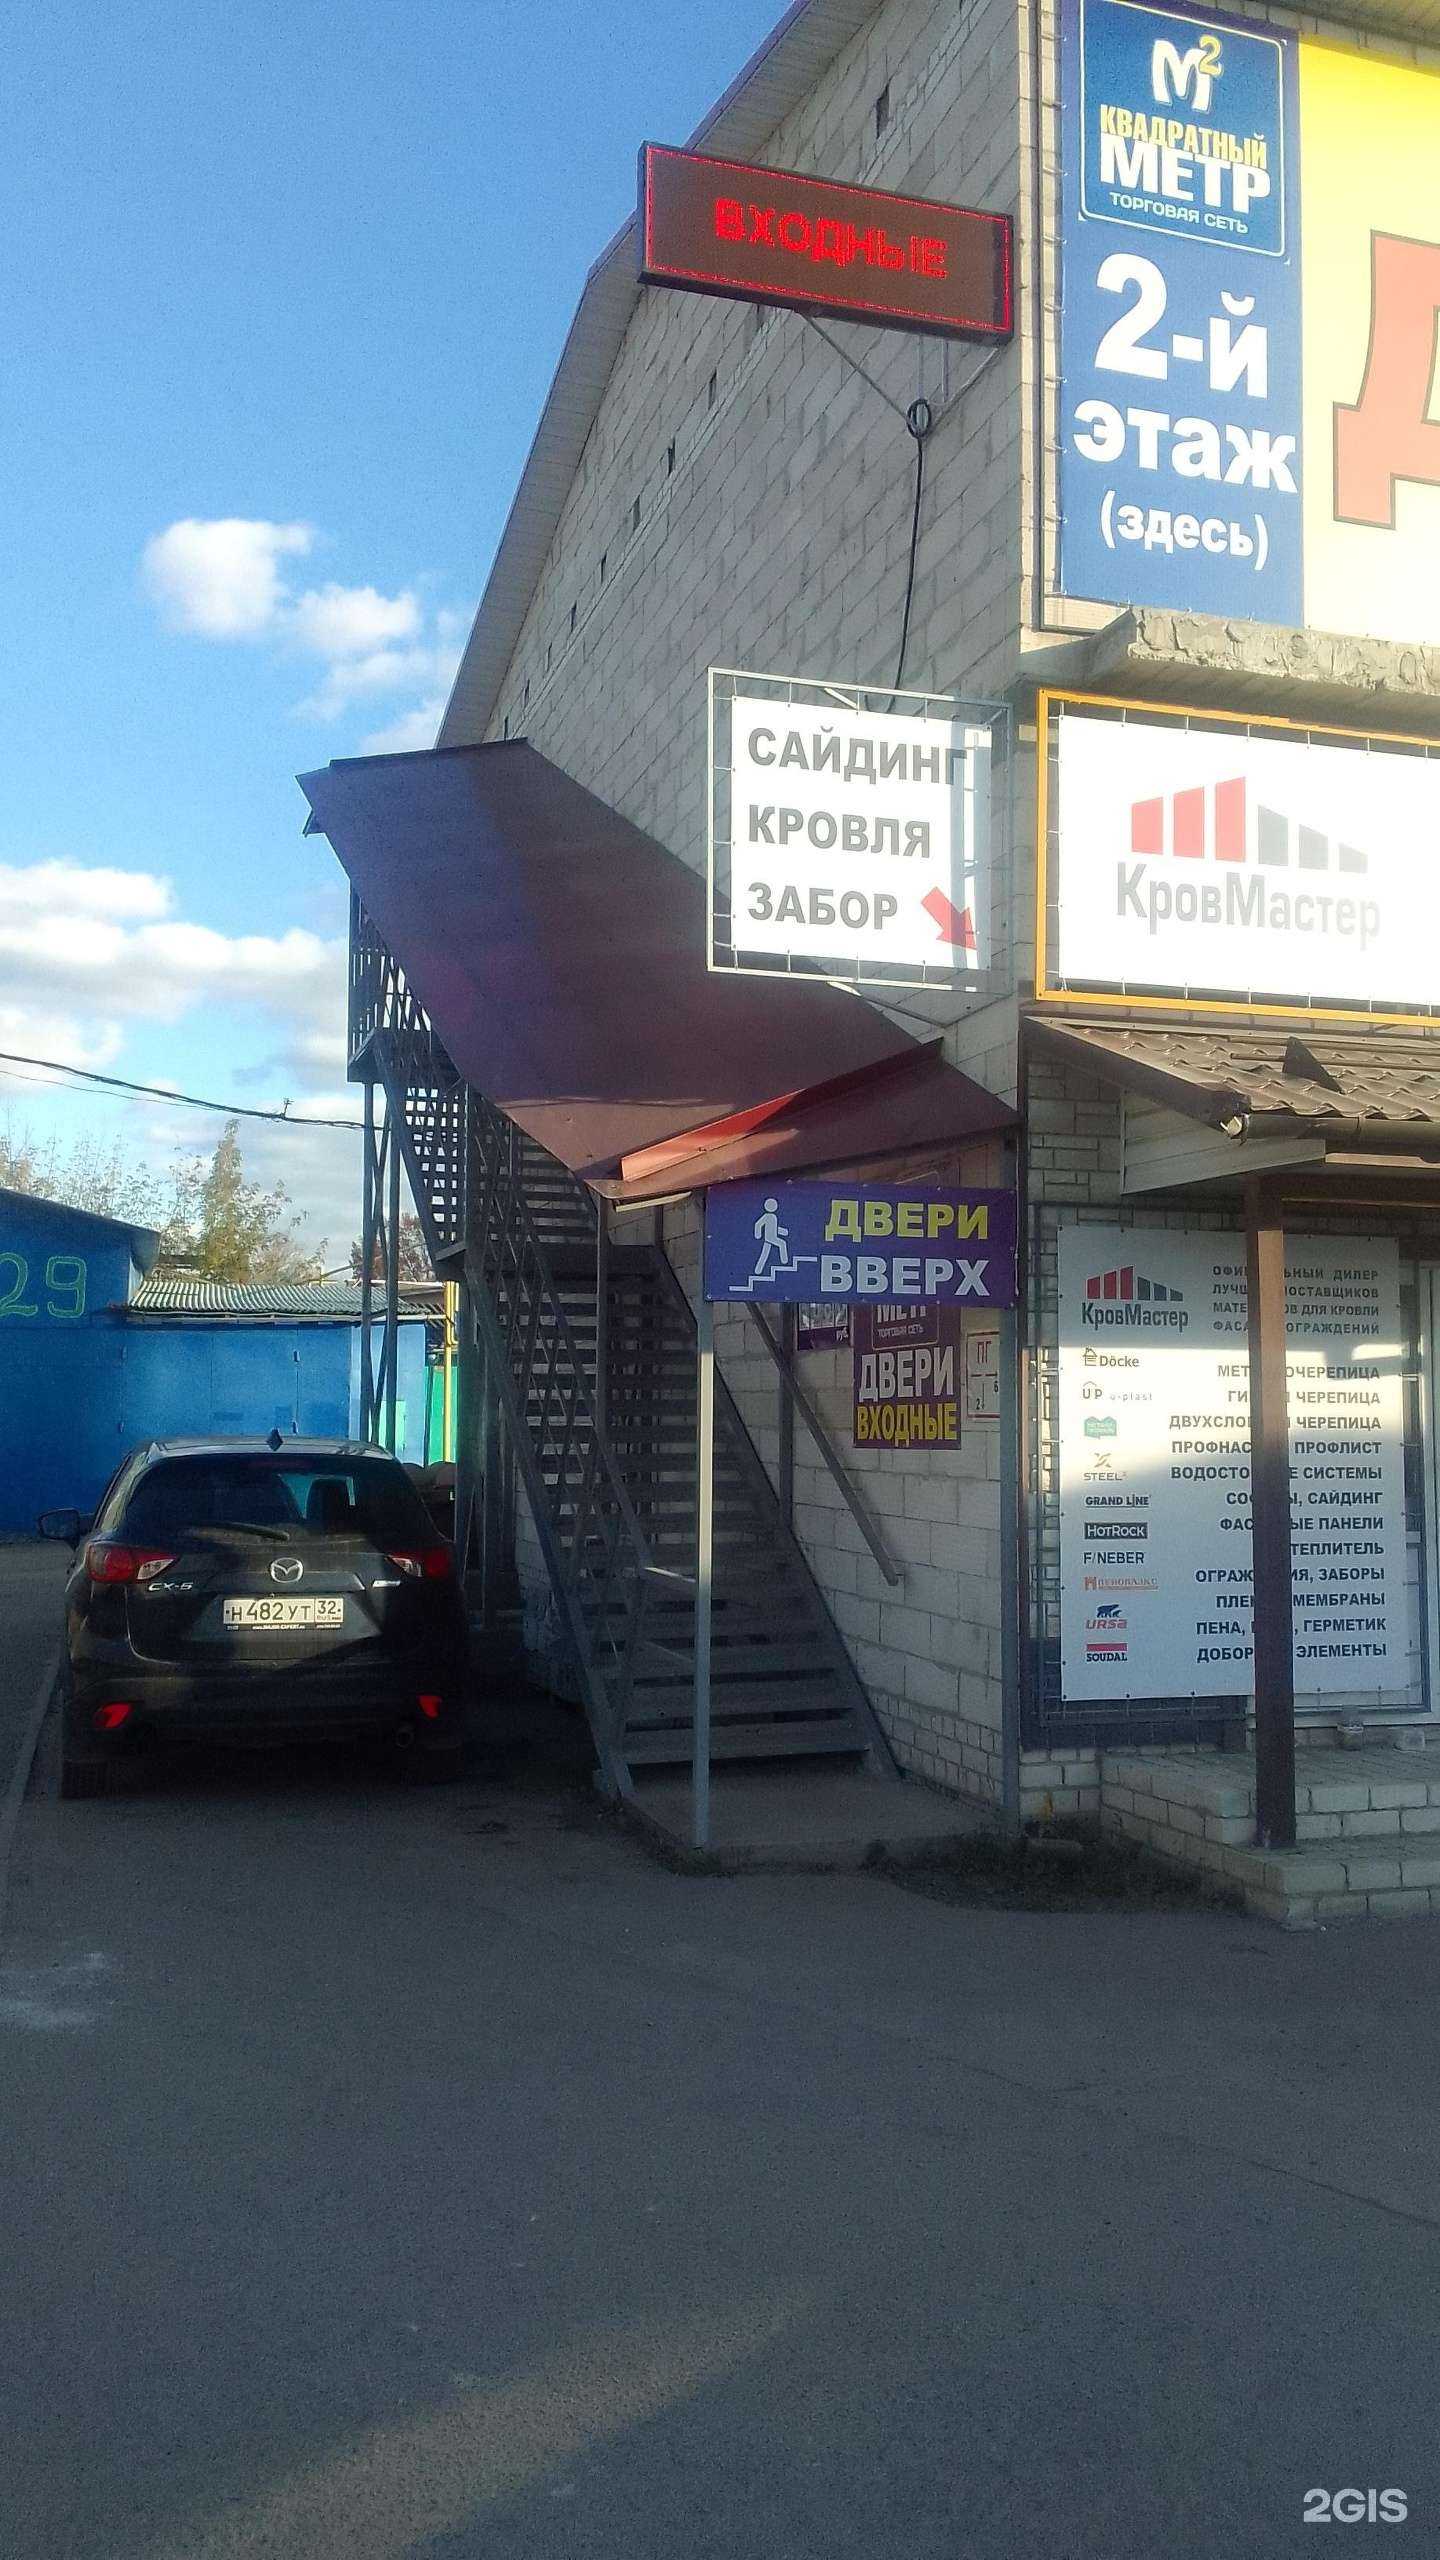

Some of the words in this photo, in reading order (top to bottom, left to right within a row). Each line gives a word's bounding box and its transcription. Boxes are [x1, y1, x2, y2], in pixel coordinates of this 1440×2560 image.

[1100, 104, 1267, 168] КВАДРАТНЫЙ
[1100, 131, 1271, 214] МЕТР
[1109, 192, 1200, 224] ТОРГОВАЯ
[1204, 213, 1248, 233] СЕТЬ
[715, 198, 948, 279] ВХОДНЫЕ
[1095, 253, 1268, 399] 2-й
[1073, 400, 1298, 493] этаж
[1101, 489, 1269, 571] (здесь)
[748, 725, 967, 785] САЙДИНГ
[748, 804, 930, 858] КРОВЛЯ
[748, 882, 897, 930] ЗАБОР
[1117, 862, 1380, 951] КровМастер
[825, 1200, 988, 1242] ДВЕРИ
[820, 1255, 990, 1296] ВВЕРХ
[1333, 1269, 1378, 1281] ДИЛЕР
[1284, 1286, 1378, 1299] ОСТАВЩИКОВ
[1082, 1302, 1189, 1333] КровМастер
[1302, 1304, 1331, 1316] ДЛЯ
[1331, 1305, 1379, 1317] КРОВЛИ
[1286, 1322, 1379, 1335] ОГРАЖДЕНИЙ
[1100, 1355, 1140, 1367] Döcke
[859, 1346, 954, 1403] ДВЕРИ
[1297, 1391, 1381, 1405] ЧЕРЕПИЦА
[857, 1403, 957, 1447] ВХОДНЫЕ
[1297, 1416, 1382, 1431] ЧЕРЕПИЦА
[1294, 1441, 1382, 1454] ПРОФЛИСТ
[1303, 1466, 1382, 1480] СИСТЕМЫ
[1086, 1496, 1123, 1506] GRAND
[1308, 1490, 1384, 1506] САЙДИНГ
[1318, 1517, 1384, 1530] ПАНЕЛИ
[1291, 1542, 1385, 1555] ТЕПЛИТЕЛЬ
[1318, 1567, 1385, 1580] ЗАБОРЫ
[148, 1582, 194, 1591] CX-5
[1293, 1593, 1385, 1607] МЕМБРАНЫ
[1196, 1621, 1245, 1636] ПЕНА,
[1303, 1618, 1387, 1632] ГЕРМЕТИК
[1086, 1653, 1128, 1662] SOUDAL
[1296, 1643, 1387, 1658] ЭЛЕМЕНТЫ
